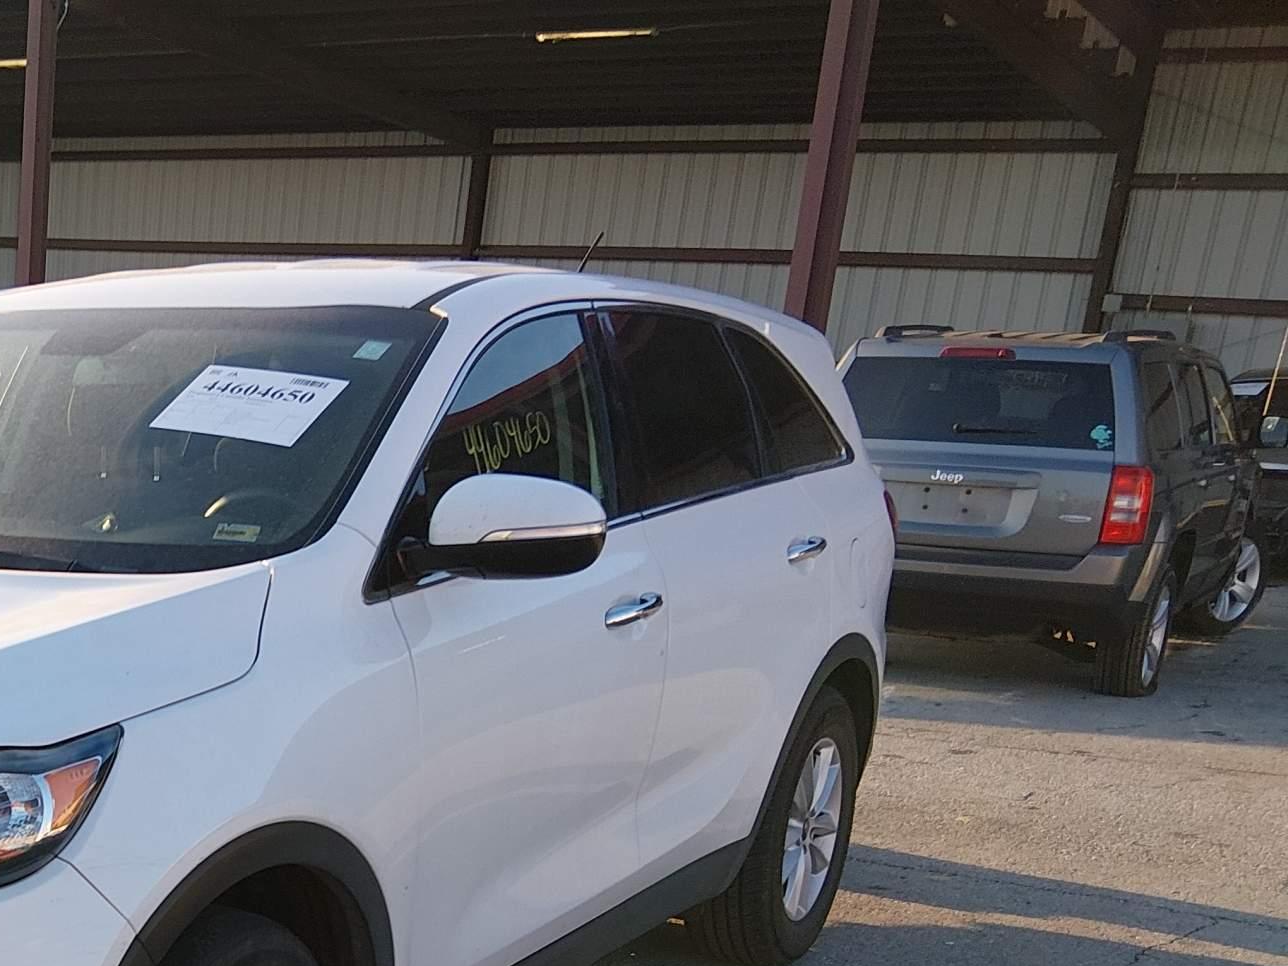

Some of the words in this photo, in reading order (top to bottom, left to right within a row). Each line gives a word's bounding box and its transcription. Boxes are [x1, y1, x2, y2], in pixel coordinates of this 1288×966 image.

[203, 380, 316, 404] 44604650
[463, 411, 550, 474] 44604650
[930, 469, 964, 484] Jeep
